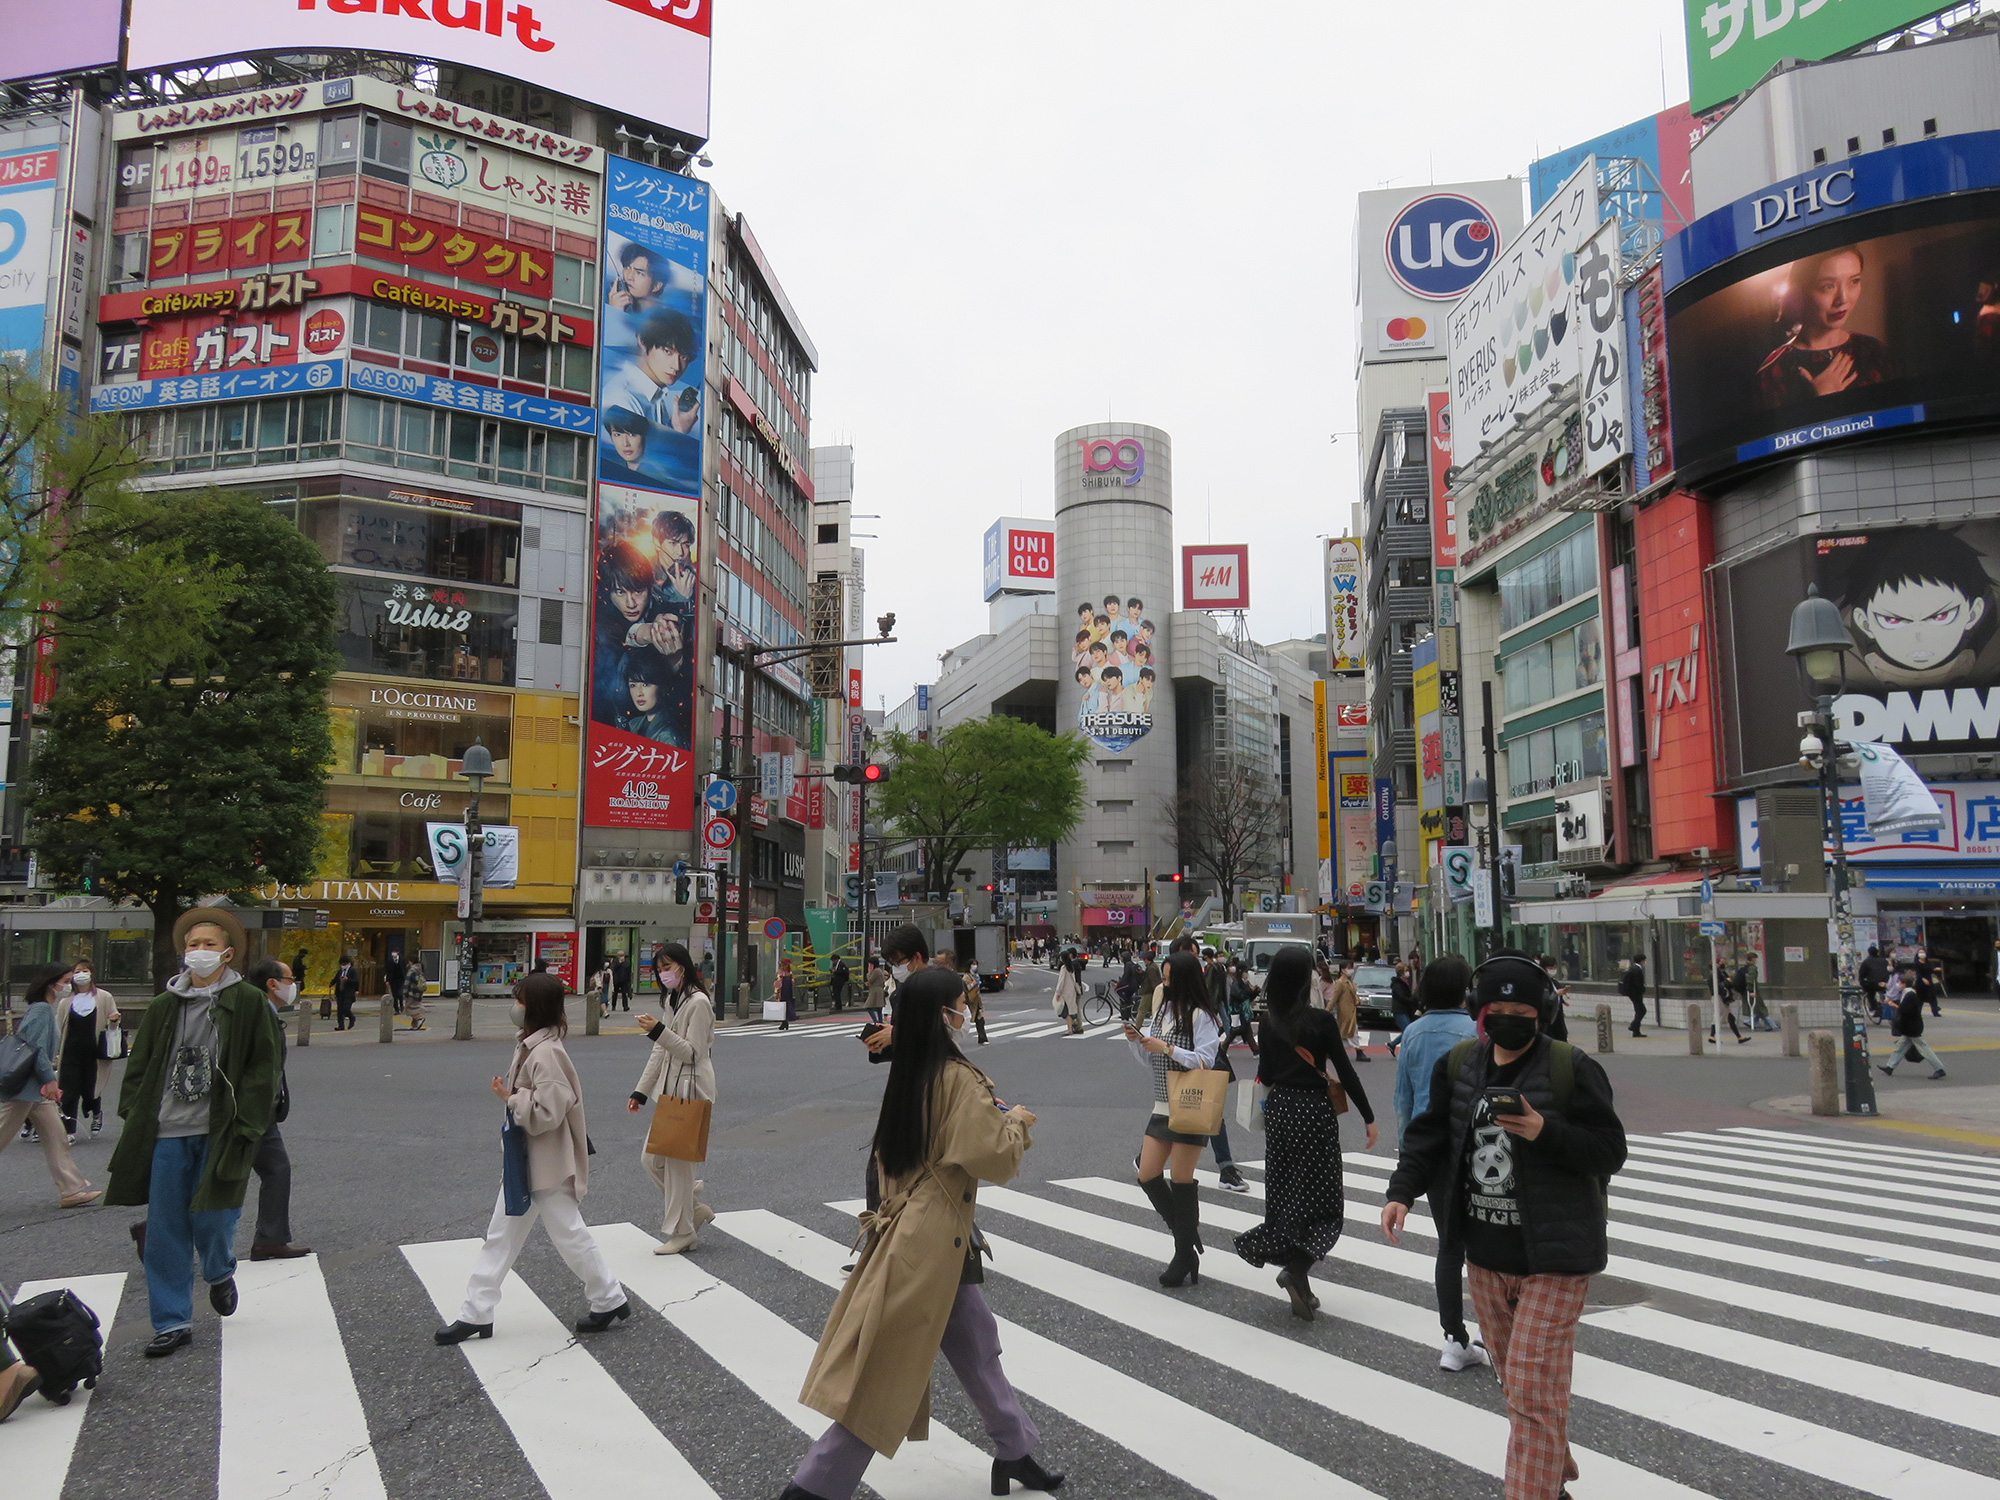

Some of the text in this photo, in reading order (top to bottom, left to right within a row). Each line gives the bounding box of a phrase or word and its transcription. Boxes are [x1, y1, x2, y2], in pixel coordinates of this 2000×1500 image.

[325, 82, 351, 101] 寿司
[136, 86, 307, 133] しゃぶしゃぶバイキング
[395, 89, 594, 164] しゃぶしゃぶバイキング
[121, 162, 153, 187] 9F
[159, 155, 231, 196] 1,199円
[239, 142, 316, 185] 1,599円
[478, 155, 592, 216] しゃぶ葉
[613, 170, 703, 212] シグナル
[1751, 167, 1857, 234] DHC
[153, 216, 307, 267] プライス
[357, 210, 547, 284] コンタクト
[1398, 218, 1490, 270] UC
[1453, 187, 1585, 350] 抗ウイルス マスク
[68, 251, 85, 324] 献血ルーム
[239, 271, 320, 313] ガスト
[308, 328, 341, 343] ガスト
[490, 300, 576, 344] ガスト
[105, 343, 141, 371] 7F
[149, 336, 190, 359] Café
[192, 322, 291, 373] ガスト
[474, 345, 497, 358] ガスト
[1388, 339, 1427, 349] mastercard
[1579, 240, 1625, 455] もんじゃ
[1457, 335, 1497, 400] BYERUS
[97, 367, 331, 409] AEON 英会話イーオン 6F
[358, 368, 592, 427] AEON 英会話イーオン
[1462, 378, 1493, 416] バイラス
[1479, 357, 1562, 437] セーレン株式会社
[1774, 415, 1875, 452] DHC Channel
[1077, 438, 1146, 486] 109
[1081, 476, 1122, 488] SHIBUYA
[1013, 535, 1047, 554] UNI
[1013, 555, 1050, 574] QLO
[1199, 566, 1233, 587] H&M
[391, 583, 467, 607] 渋谷焼肉
[851, 583, 862, 633] AMERA
[383, 598, 473, 633] Ushi8
[369, 687, 478, 712] L'OCCITANE
[850, 679, 860, 700] 免税
[1441, 685, 1449, 700] バー
[1449, 677, 1458, 698] ダーツ
[406, 710, 459, 721] PROVENCE
[812, 700, 821, 722] レイク
[1080, 712, 1152, 727] TREASURE
[811, 724, 820, 752] ALSA
[1089, 726, 1143, 736] 3.31 DEBUT!
[592, 743, 689, 774] シグナル
[1318, 737, 1327, 782] Matsumoto
[1421, 730, 1443, 781] 薬
[621, 780, 659, 800] 4.02
[769, 756, 778, 796] 渋谷駅前
[1346, 775, 1368, 796] 薬
[399, 791, 442, 813] Café
[609, 797, 670, 811] ROADSHOW
[810, 791, 820, 816] アコム
[1381, 786, 1389, 821] MIZUHO
[1966, 845, 1993, 853] BOOKS
[784, 851, 806, 880] LUSH
[1937, 881, 1997, 889] TAISEIDO
[1106, 910, 1126, 925] 109
[1267, 922, 1292, 930] TANAKA
[1180, 1088, 1204, 1097] LUSH
